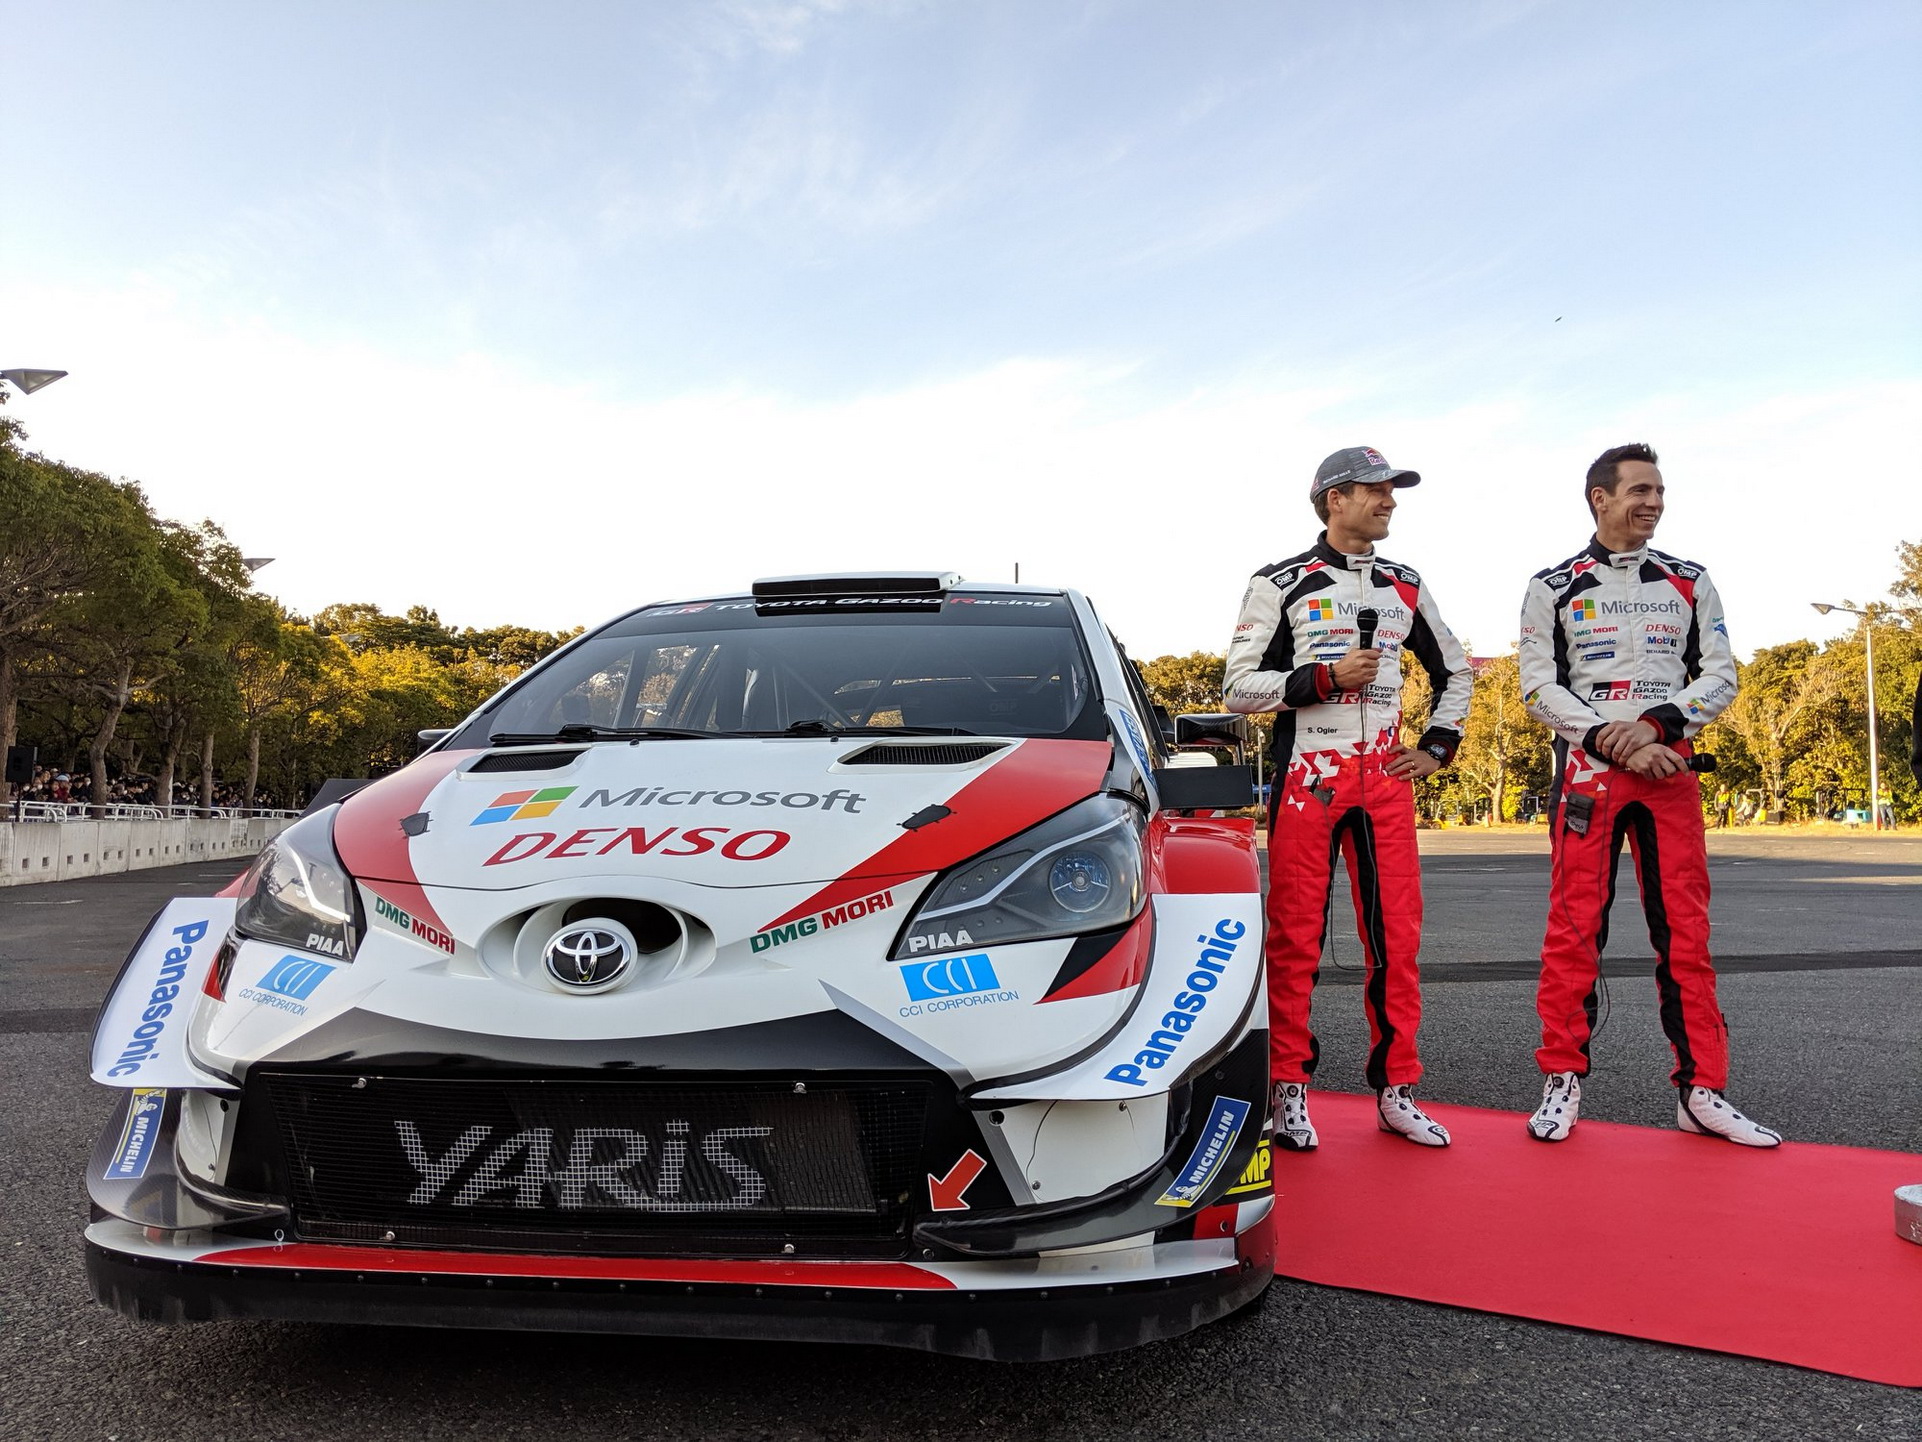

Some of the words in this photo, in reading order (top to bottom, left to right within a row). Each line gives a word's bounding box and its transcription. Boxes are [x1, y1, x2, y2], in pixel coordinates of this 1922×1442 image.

[716, 599, 827, 611] TOYOTA
[950, 597, 1052, 607] Racing
[1601, 599, 1680, 615] Microsoft
[1307, 630, 1329, 638] DMG
[1329, 628, 1354, 636] MORI
[1377, 629, 1405, 641] DENSO
[1645, 624, 1681, 635] DENSO
[1309, 641, 1351, 649] Panasonic
[1575, 639, 1617, 649] Panasonic
[1233, 689, 1280, 700] Microsoft
[1589, 688, 1629, 701] GR
[1636, 680, 1672, 688] TOYOTA
[1632, 693, 1669, 701] Racing
[1536, 700, 1579, 734] Microsoft
[1317, 726, 1338, 735] Ogier
[578, 787, 867, 814] Microsoft
[480, 827, 791, 868] DENSO
[374, 896, 411, 930] DMG
[410, 921, 456, 956] MORI
[749, 917, 818, 954] DMG
[819, 890, 895, 930] MORI
[306, 933, 345, 956] PIAA
[908, 929, 975, 953] PIAA
[922, 958, 978, 994] CCI
[106, 919, 210, 1078] Panasonic
[239, 987, 254, 999] CCI
[254, 992, 308, 1016] CORPORATION
[899, 1006, 924, 1018] CCI
[926, 990, 1020, 1014] CORPORATION
[1103, 918, 1246, 1087] Panasonic
[120, 1116, 150, 1173] MICHELIN
[1188, 1109, 1235, 1184] MICHELIN
[1240, 1148, 1271, 1184] MP
